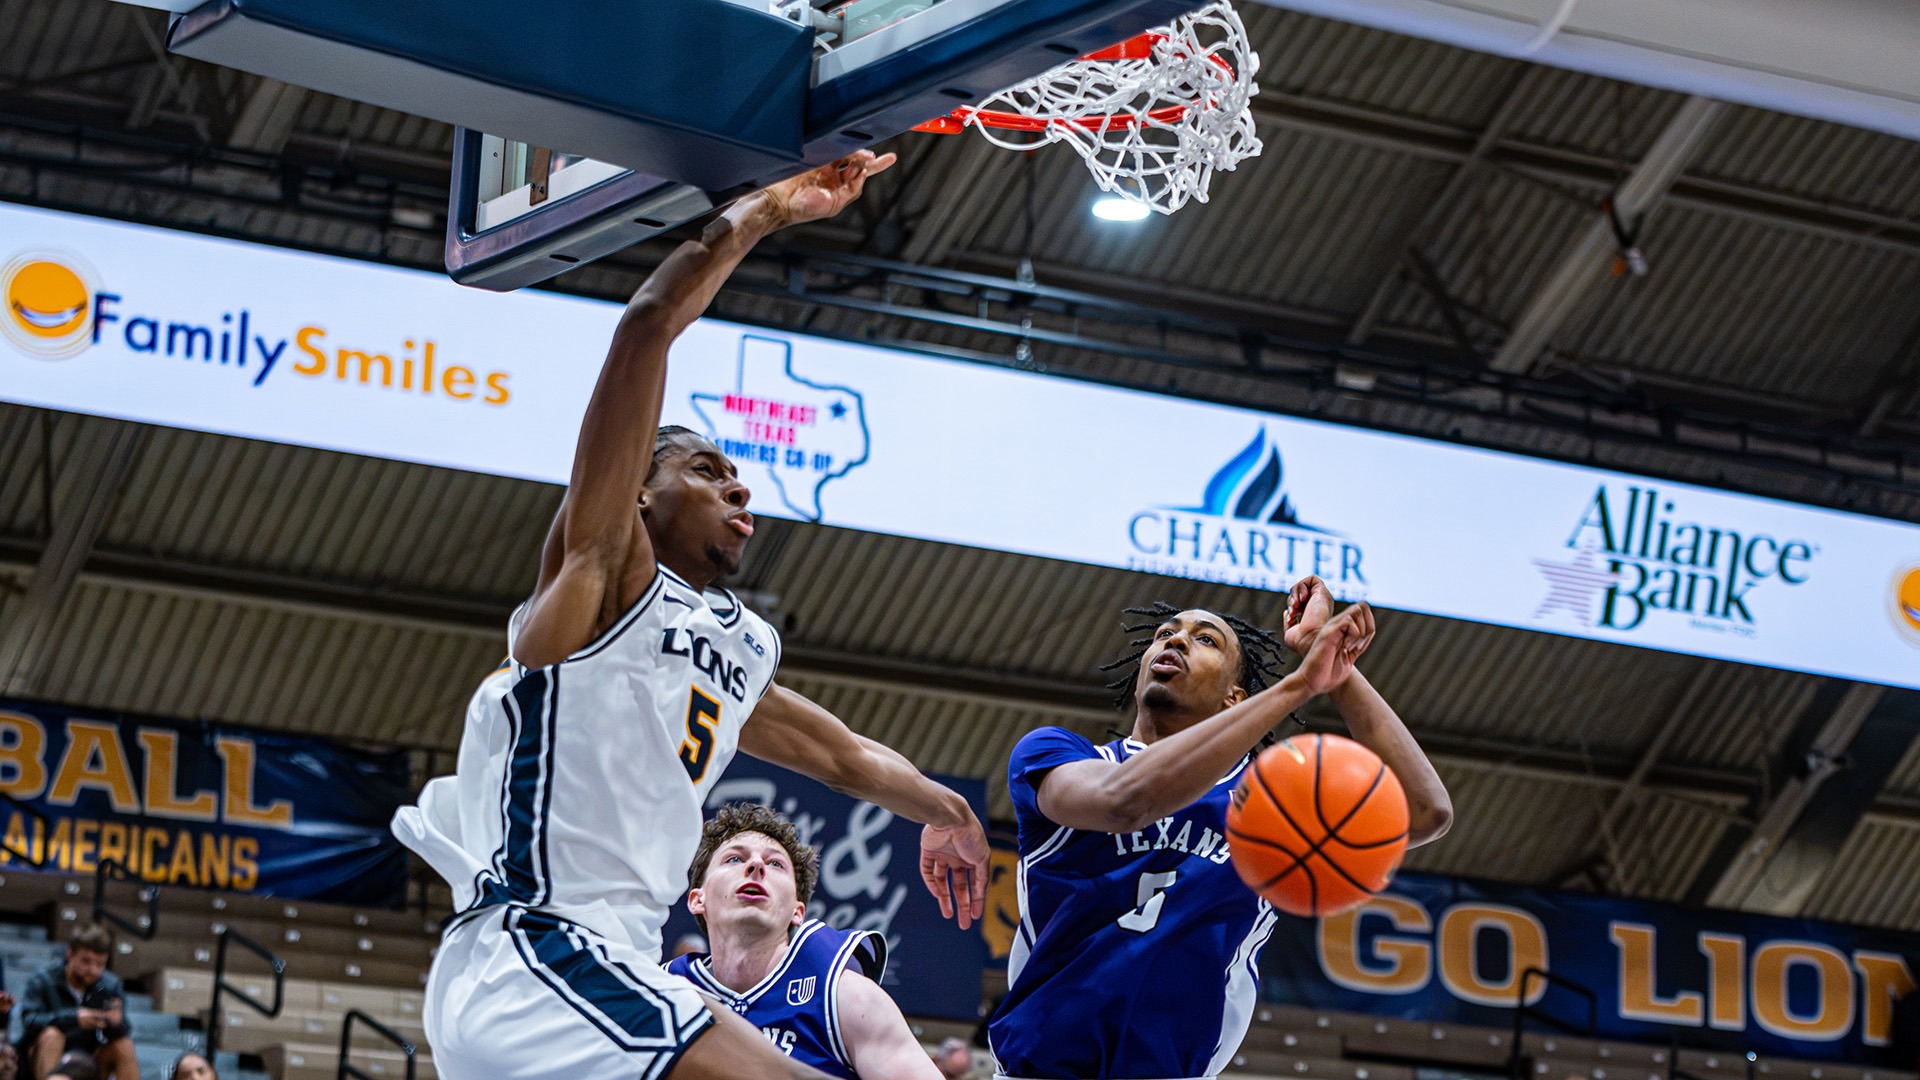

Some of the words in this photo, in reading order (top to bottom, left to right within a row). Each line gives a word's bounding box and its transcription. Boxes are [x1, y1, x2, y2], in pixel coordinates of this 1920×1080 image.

[723, 395, 816, 426] NORTHEAST
[744, 420, 795, 446] TEXAS
[1128, 511, 1369, 585] CHARTER
[1565, 484, 1812, 584] Alliance
[1598, 558, 1755, 631] Bank
[0, 711, 293, 829] BALL
[679, 683, 723, 786] 5
[1107, 816, 1232, 865] TEXANS
[1116, 869, 1178, 934] 5
[1317, 894, 1550, 1009] GO
